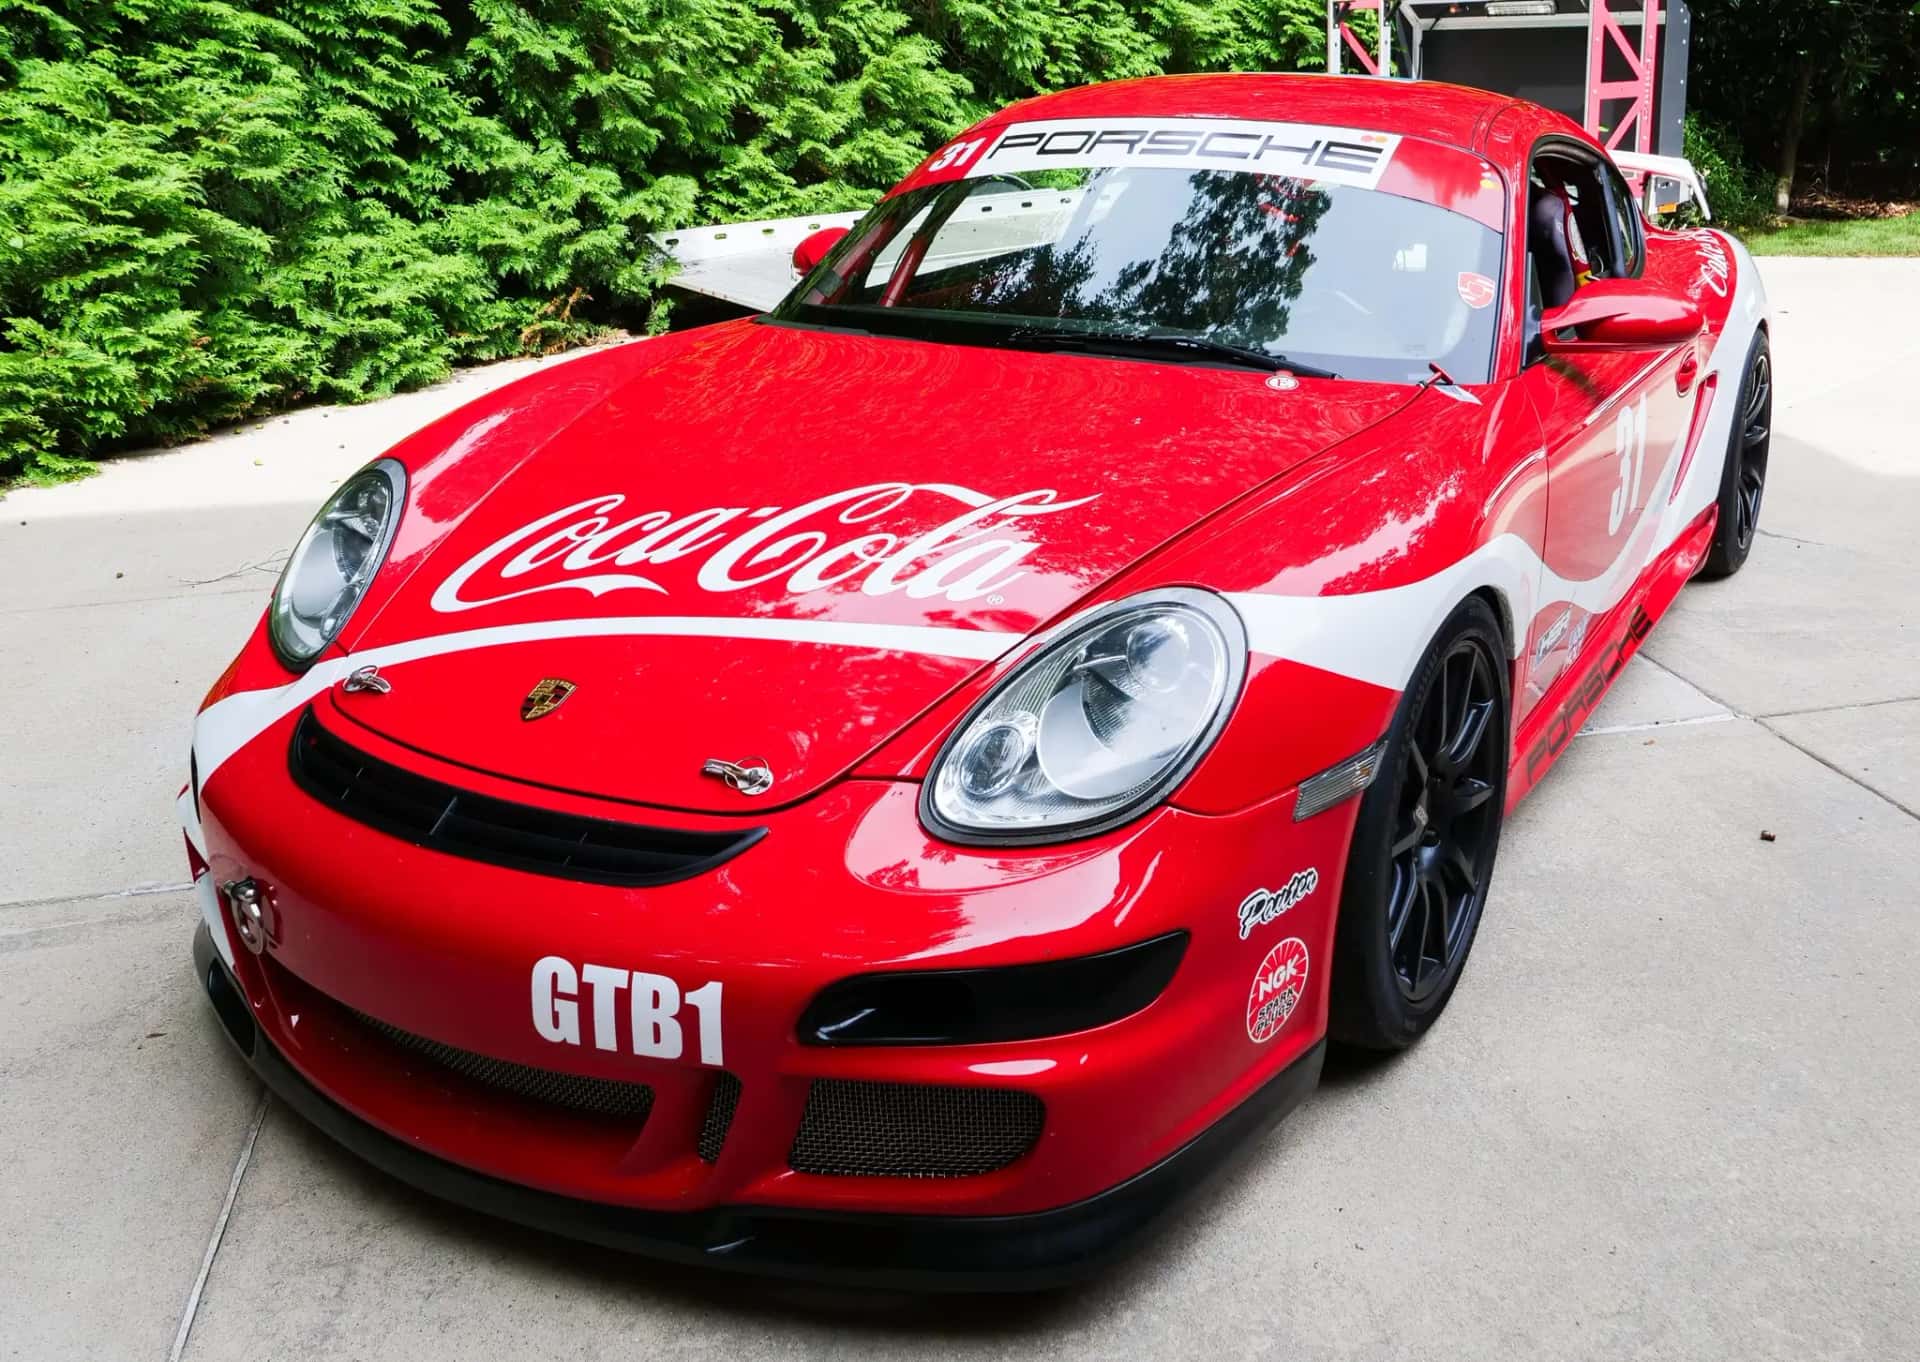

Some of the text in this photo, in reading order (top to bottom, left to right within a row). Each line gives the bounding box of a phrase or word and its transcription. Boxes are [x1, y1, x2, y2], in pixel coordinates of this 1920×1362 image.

[928, 138, 987, 173] 31
[988, 130, 1385, 174] PORSCHE
[1608, 392, 1648, 536] 31
[431, 482, 1102, 613] Coca-Cola
[1528, 604, 1655, 786] PORSCHE
[1259, 954, 1299, 1001] NGK
[531, 955, 724, 1067] GTB1
[1257, 999, 1294, 1033] PLUGS
[1258, 985, 1295, 1019] SPARK
